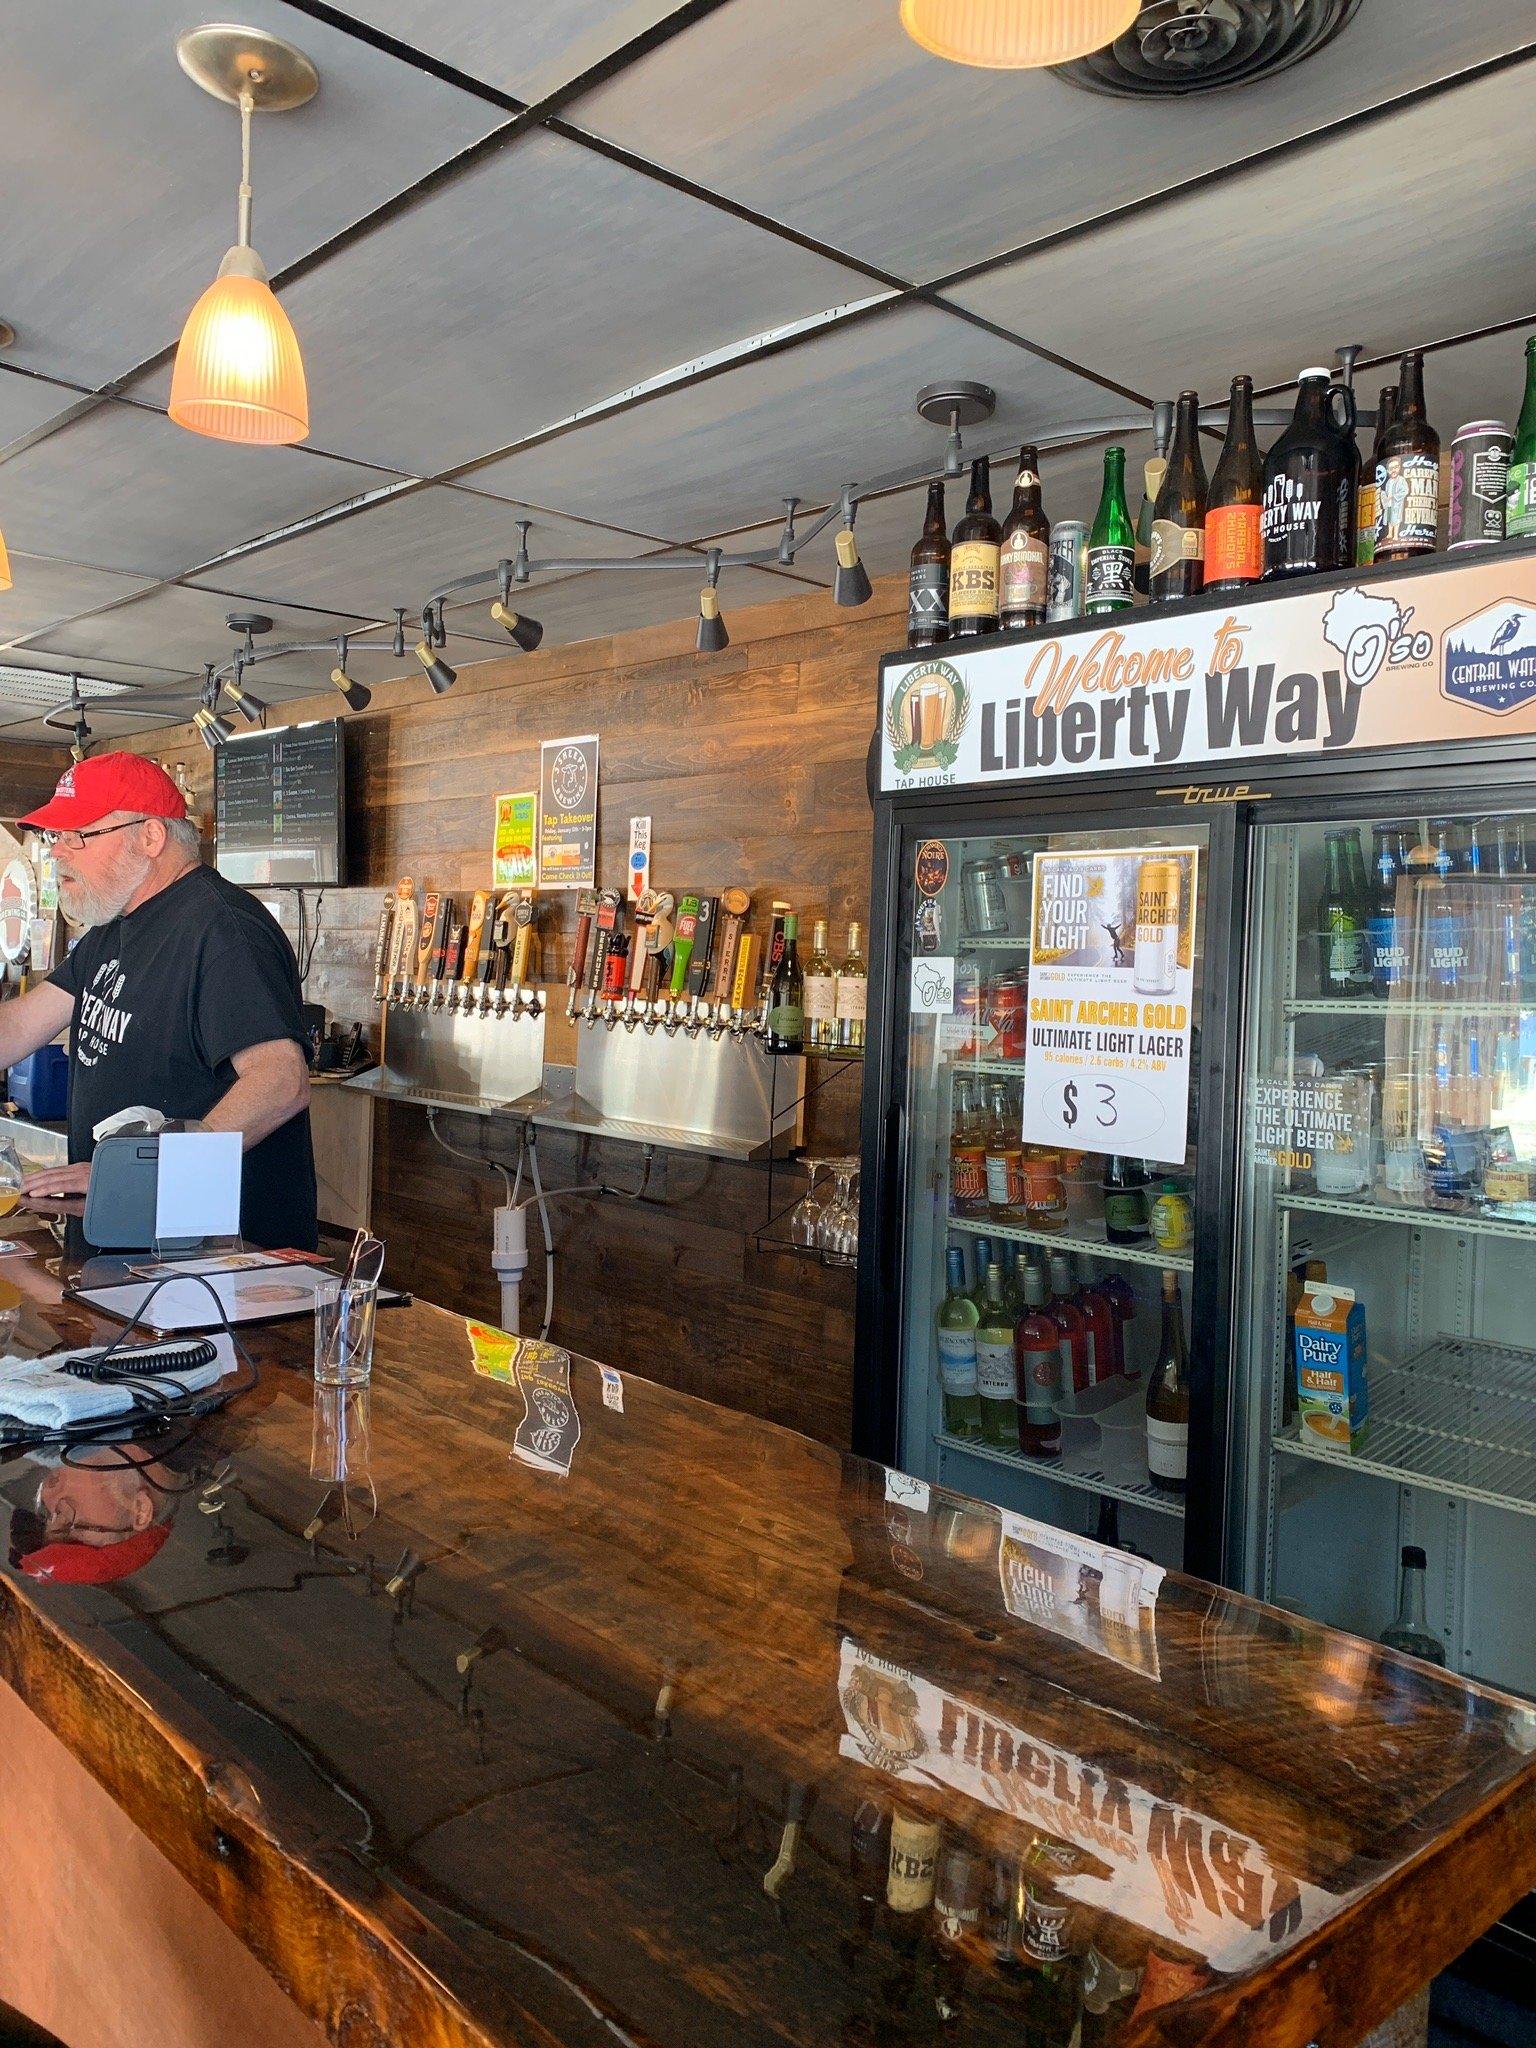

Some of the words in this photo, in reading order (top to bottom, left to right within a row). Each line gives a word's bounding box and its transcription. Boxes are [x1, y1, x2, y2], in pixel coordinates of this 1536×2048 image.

[1292, 501, 1321, 521] WAY
[1273, 522, 1305, 534] HOUSE
[952, 570, 995, 592] KBS
[1098, 561, 1125, 590] 黑
[909, 588, 948, 615] XX
[1024, 630, 1196, 718] Welcome
[1208, 615, 1252, 677] to
[1386, 662, 1420, 672] BREWING
[1422, 660, 1434, 668] CO
[1452, 661, 1502, 685] CENTRAL
[1508, 657, 1536, 678] WAT
[900, 663, 939, 693] LIBERTY
[940, 664, 960, 686] WAY
[1469, 682, 1517, 694] BREWING
[981, 686, 1191, 773] Liberty
[1205, 663, 1363, 749] Way
[558, 749, 586, 772] SHEEPS
[895, 779, 915, 789] TAP
[918, 774, 957, 787] HOUSE
[555, 785, 584, 805] BREWING
[1173, 785, 1257, 804] true
[543, 814, 558, 827] Tap
[560, 812, 594, 825] Takeover
[635, 820, 647, 830] Kill
[634, 830, 648, 840] This
[634, 839, 647, 851] Keg
[922, 851, 945, 861] NOIRE
[542, 872, 557, 880] Come
[559, 871, 575, 880] Check
[1043, 874, 1083, 900] FIND
[1139, 891, 1168, 907] SAINT
[699, 900, 710, 922] 3
[1041, 900, 1088, 925] YOUR
[1139, 908, 1178, 924] ARCHER
[376, 913, 387, 945] ALMANAC
[1039, 925, 1090, 950] LIGHT
[1137, 927, 1164, 943] GOLD
[592, 930, 606, 989] DESCHUTES
[721, 933, 734, 983] SIERRA
[1373, 956, 1410, 968] LIGHT
[1376, 947, 1405, 958] BUD
[1430, 956, 1469, 969] LIGHT
[1433, 947, 1464, 958] BUD
[1050, 972, 1066, 982] GOLD
[101, 1004, 133, 1044] WAY
[1030, 998, 1074, 1023] SAINT
[1077, 1000, 1139, 1027] ARCHER
[1143, 1004, 1187, 1030] GOLD
[1033, 1028, 1092, 1051] ULTIMATE
[1096, 1032, 1134, 1053] LIGHT
[1139, 1035, 1184, 1058] LAGER
[1044, 1051, 1053, 1061] 95
[1055, 1052, 1084, 1065] calories
[1089, 1055, 1101, 1065] 2.6
[1103, 1056, 1124, 1068] carbs
[1151, 1060, 1167, 1072] ABV
[1062, 1080, 1078, 1129] $
[1095, 1083, 1118, 1127] 3
[1256, 1087, 1344, 1111] EXPERIENCE
[1255, 1106, 1281, 1125] THE
[1284, 1108, 1353, 1132] ULTIMATE
[1254, 1125, 1294, 1145] LIGHT
[1296, 1129, 1335, 1150] BEER
[1278, 1151, 1312, 1169] GOLD
[1300, 1334, 1342, 1355] Dairy
[1303, 1348, 1338, 1364] Pure
[1311, 1369, 1332, 1379] Half
[1316, 1377, 1337, 1387] Half
